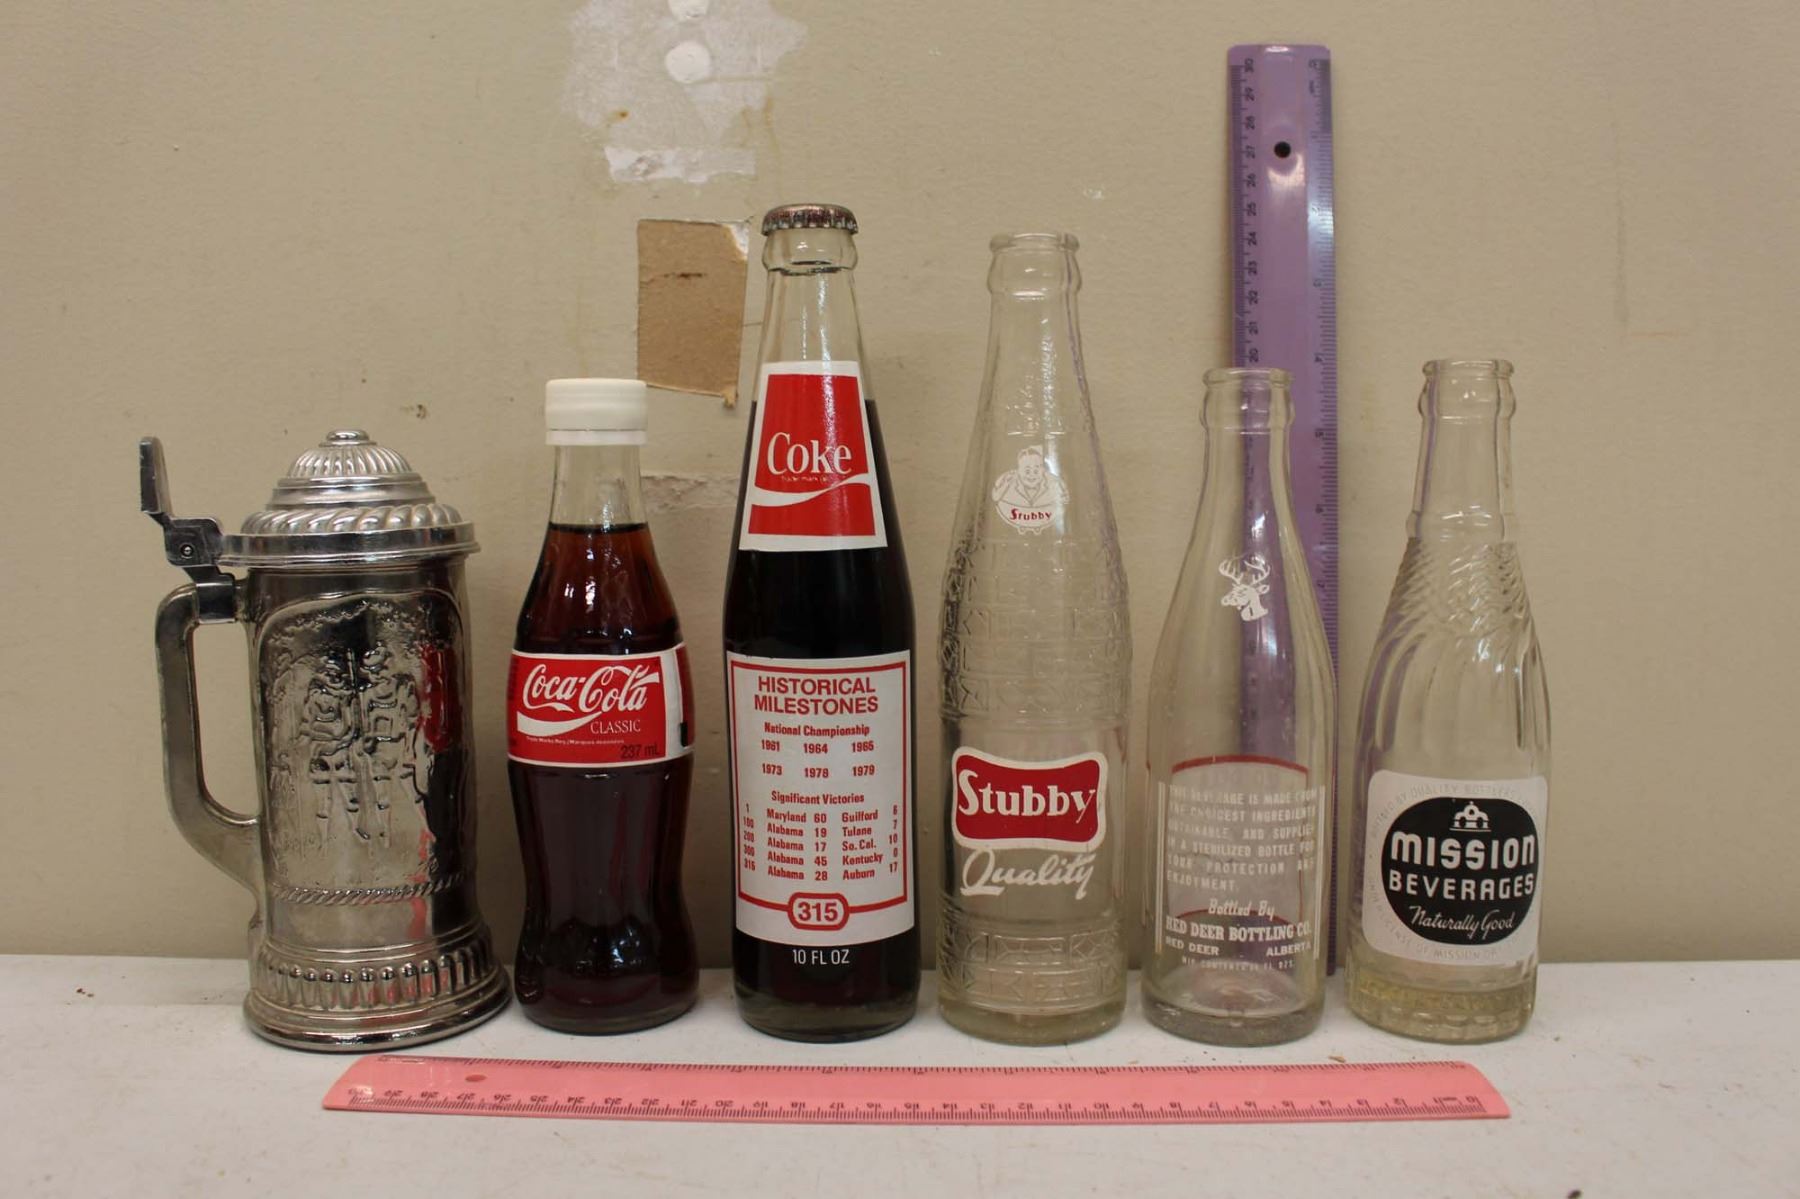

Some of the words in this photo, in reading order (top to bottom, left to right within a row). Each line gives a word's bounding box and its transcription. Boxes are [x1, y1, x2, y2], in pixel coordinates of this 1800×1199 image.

[1246, 231, 1257, 247] 24
[767, 432, 852, 475] Coke
[1010, 508, 1052, 520] Stubby
[522, 664, 660, 713] Coca-Cola
[758, 676, 876, 695] HISTORICAL
[754, 694, 878, 715] MILESTONES
[590, 720, 641, 735] CLASSIC
[764, 722, 801, 736] National
[804, 724, 870, 739] Championship
[620, 746, 640, 760] 237
[762, 739, 780, 752] 1961
[803, 743, 828, 754] 1964
[762, 763, 783, 776] 1973
[804, 767, 829, 779] 1978
[852, 764, 875, 777] 1979
[771, 790, 820, 804] Significant
[822, 793, 865, 805] Victories
[958, 769, 1096, 824] Stubby
[767, 808, 807, 823] Maryland
[814, 812, 827, 823] 60
[842, 809, 878, 823] Guilford
[767, 823, 804, 837] Alabama
[814, 828, 827, 838] 19
[842, 826, 872, 837] Tulane
[1243, 828, 1264, 840] AND
[767, 837, 804, 851] Alabama
[814, 842, 827, 852] 17
[842, 840, 857, 852] So.
[859, 838, 877, 850] Cal.
[889, 833, 898, 845] 10
[1258, 844, 1295, 858] BOTTLE
[1391, 831, 1536, 870] MISSION
[768, 851, 805, 865] Alabama
[814, 856, 828, 867] 45
[842, 852, 884, 866] Kentucky
[1206, 860, 1285, 876] PROTECTION
[768, 866, 805, 880] Alabama
[814, 870, 828, 881] 28
[842, 869, 875, 881] Auburn
[889, 861, 898, 873] 17
[960, 850, 1097, 900] Quality
[1389, 868, 1535, 901] BEVERAGES
[798, 901, 839, 922] 315
[1208, 898, 1251, 917] Bottled
[1258, 900, 1275, 922] By
[1166, 915, 1187, 934] RED
[1191, 922, 1225, 940] DEER
[1229, 924, 1294, 942] BOTTLING
[1409, 905, 1480, 940] Naturally
[1480, 908, 1516, 940] Good
[1166, 936, 1184, 950] RED
[1188, 942, 1220, 956] DEER
[1266, 941, 1312, 957] ALBERTA
[793, 948, 806, 965] 10
[812, 950, 827, 965] FL
[831, 948, 850, 965] OZ
